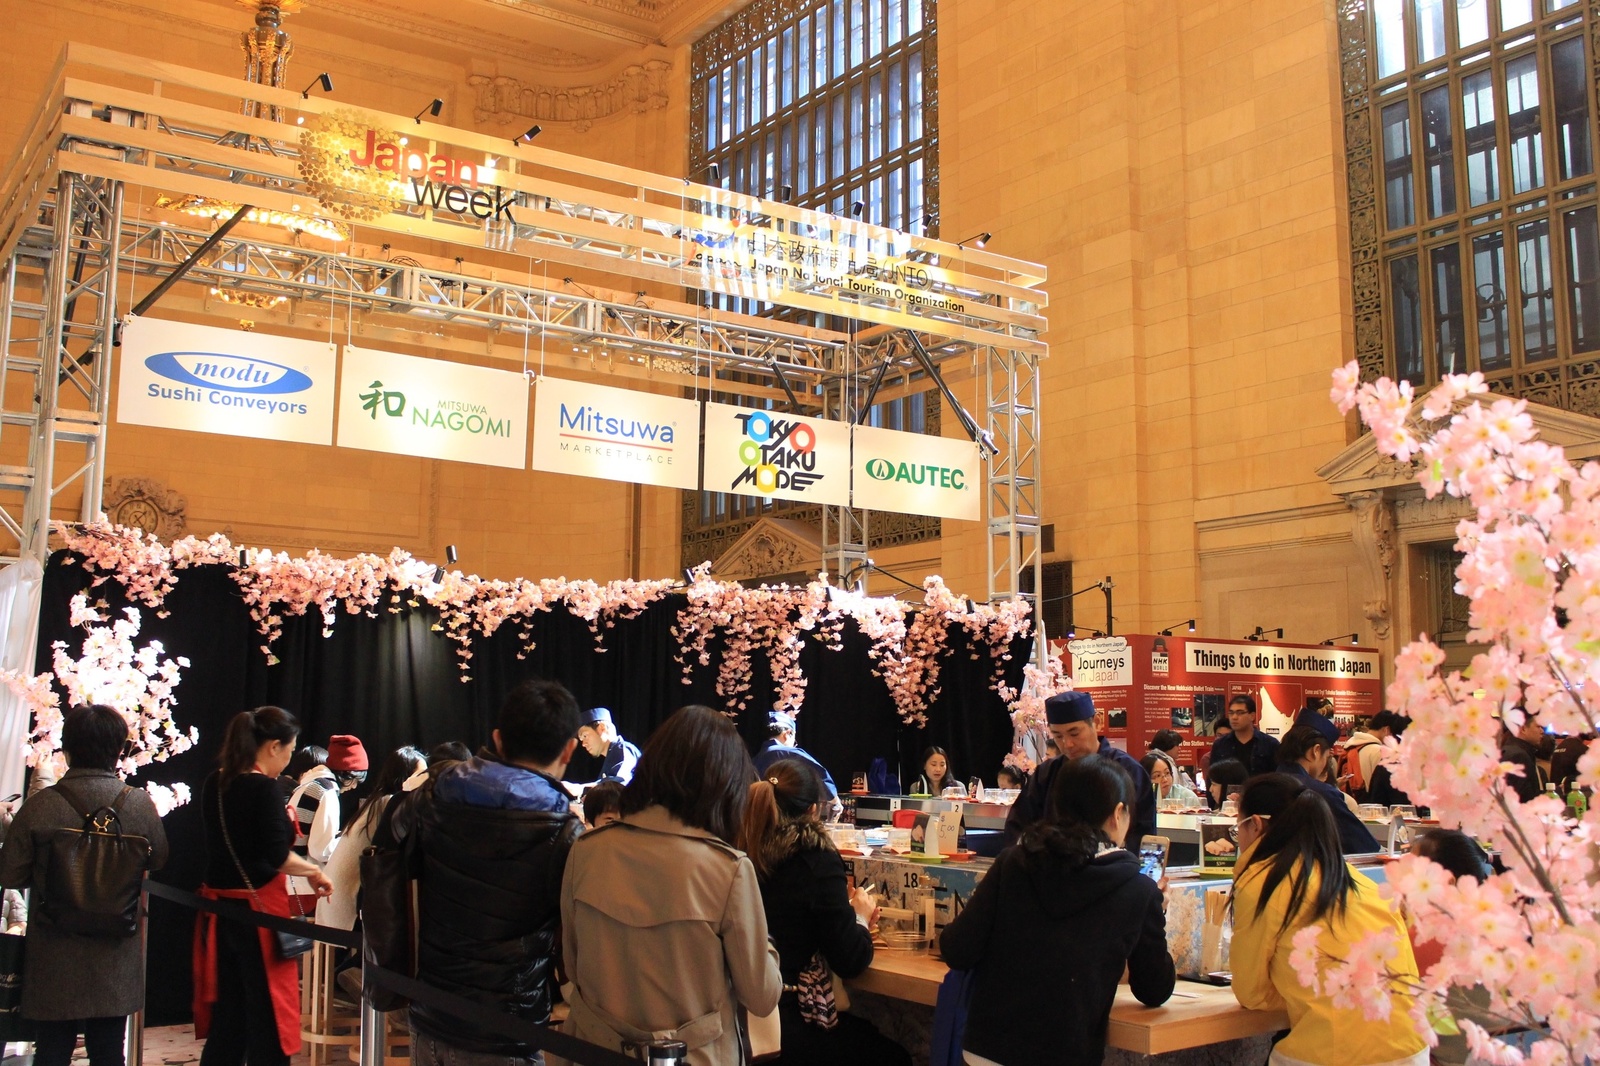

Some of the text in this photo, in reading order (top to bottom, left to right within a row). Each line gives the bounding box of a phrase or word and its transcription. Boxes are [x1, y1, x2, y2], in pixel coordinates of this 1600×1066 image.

[350, 130, 478, 189] Japan
[751, 259, 788, 276] Japan
[848, 278, 891, 297] Tourism
[895, 289, 965, 313] Organization
[193, 361, 270, 384] modu
[147, 383, 307, 414] Sushi Conveyors
[359, 380, 406, 420] 和
[437, 400, 488, 415] MITSUWA
[412, 406, 511, 438] NAGOMI
[560, 403, 674, 443] Mitsuwa
[734, 411, 816, 454] TOKYO
[560, 442, 673, 465] MARKETPLACE
[739, 440, 816, 471] OTAKU
[731, 463, 825, 493] MODE
[895, 462, 965, 490] AUTEC
[1078, 657, 1125, 670] Journeys
[1194, 649, 1372, 676] Things to do in Northern Japan
[1079, 670, 1119, 685] in Japan
[892, 800, 898, 809] 1
[954, 805, 960, 813] 2
[903, 872, 919, 889] 18
